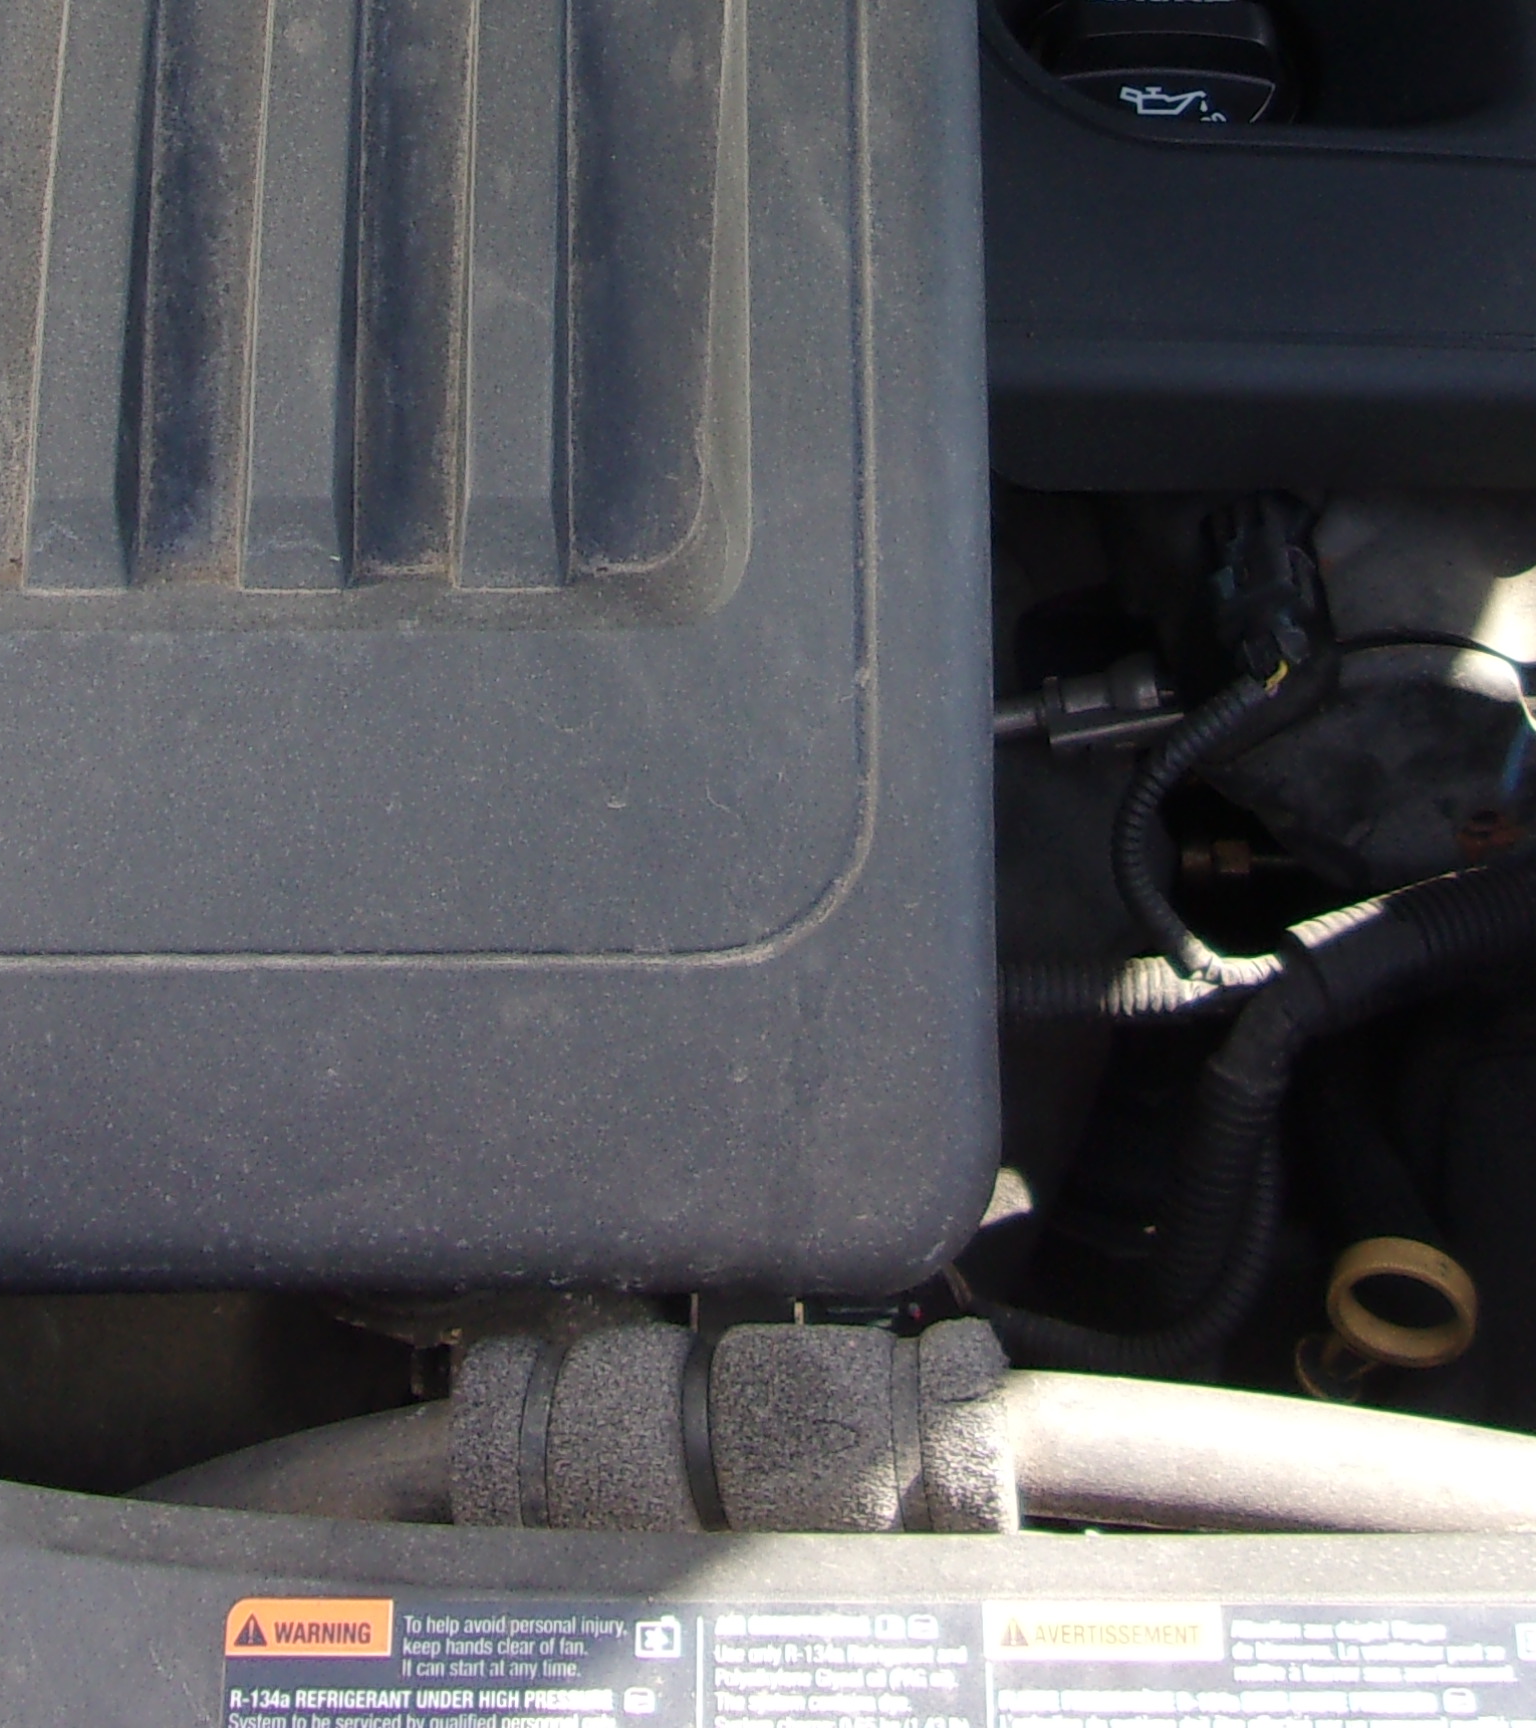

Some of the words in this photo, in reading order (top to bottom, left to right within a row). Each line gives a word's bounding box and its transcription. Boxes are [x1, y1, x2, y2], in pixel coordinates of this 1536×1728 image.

[274, 1621, 372, 1645] WARNING
[403, 1615, 422, 1634] To
[426, 1615, 459, 1636] help
[463, 1616, 506, 1634] avoid
[510, 1617, 577, 1637] personal
[581, 1616, 627, 1638] injury,
[1034, 1624, 1200, 1645] AVERTISSEMENT
[402, 1638, 441, 1658] keep
[445, 1638, 492, 1656] hands
[497, 1638, 534, 1656] clear
[539, 1638, 556, 1656] of
[559, 1639, 588, 1656] fan.
[402, 1660, 412, 1677] It
[416, 1663, 445, 1677] can
[449, 1660, 485, 1677] start
[489, 1660, 505, 1677] at
[509, 1663, 537, 1681] any
[542, 1659, 582, 1677] time.
[229, 1689, 290, 1709] R-134a
[295, 1689, 412, 1709] REFRIGERANT
[416, 1689, 474, 1709] UNDER
[478, 1689, 519, 1709] HIGH
